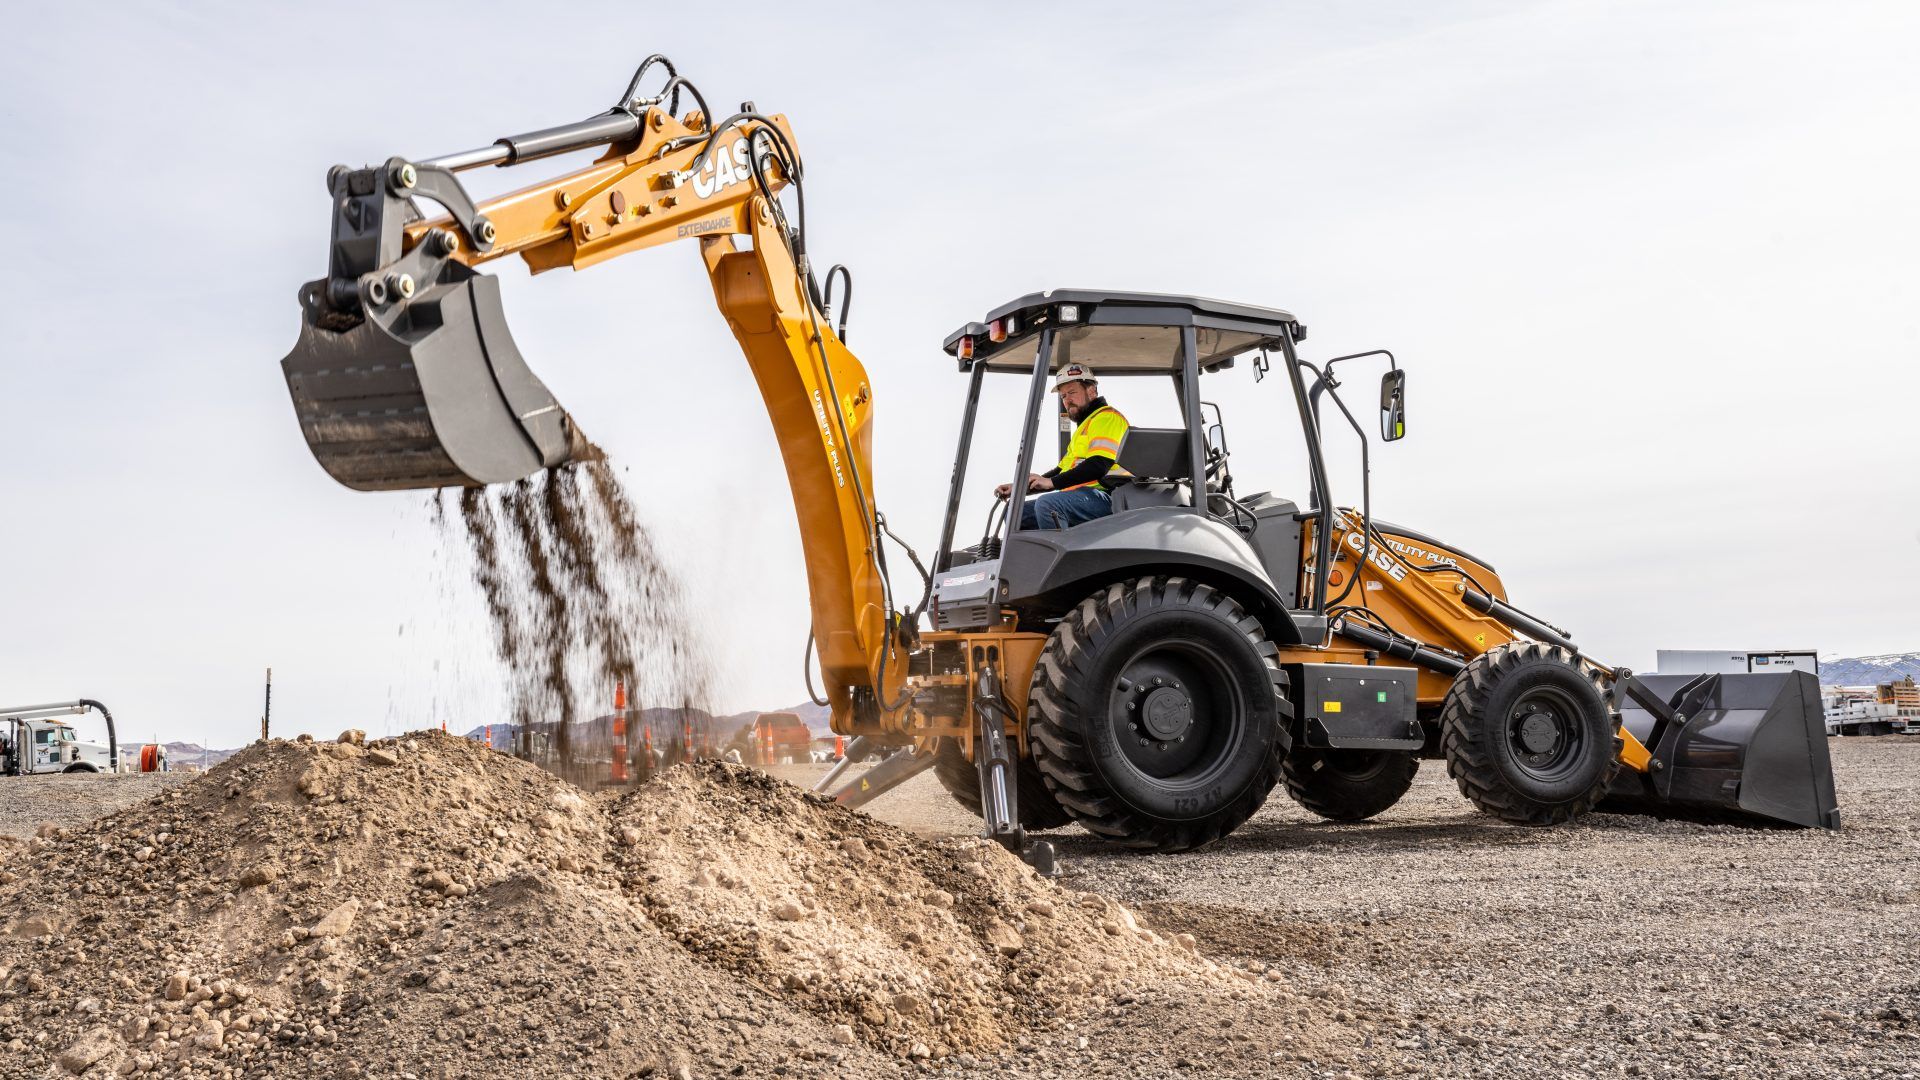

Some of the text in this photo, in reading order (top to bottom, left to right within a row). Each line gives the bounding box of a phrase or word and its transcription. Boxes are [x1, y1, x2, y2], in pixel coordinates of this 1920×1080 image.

[677, 216, 731, 238] EXTENDAHOE
[813, 389, 845, 489] UTILITY PLUS
[1427, 552, 1457, 566] PLUS
